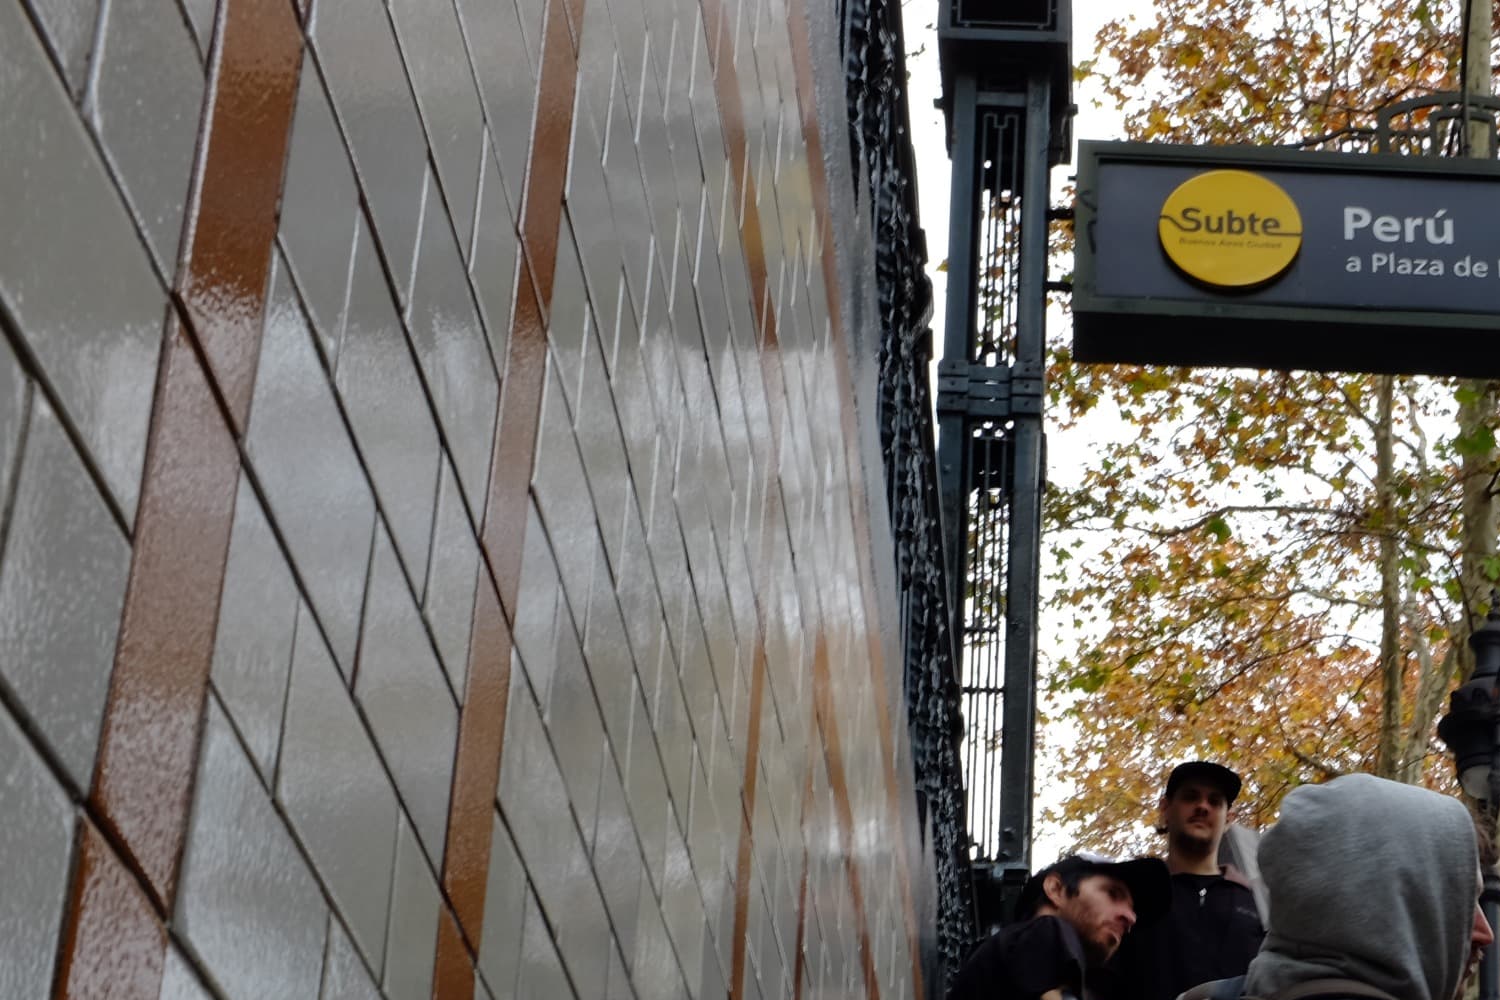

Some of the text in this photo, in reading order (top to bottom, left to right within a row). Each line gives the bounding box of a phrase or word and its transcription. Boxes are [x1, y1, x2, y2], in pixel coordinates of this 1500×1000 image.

[1180, 207, 1281, 236] Subte
[1343, 206, 1455, 245] Perú
[1345, 255, 1362, 273] a
[1371, 252, 1445, 276] Plaza
[1453, 255, 1489, 278] de
